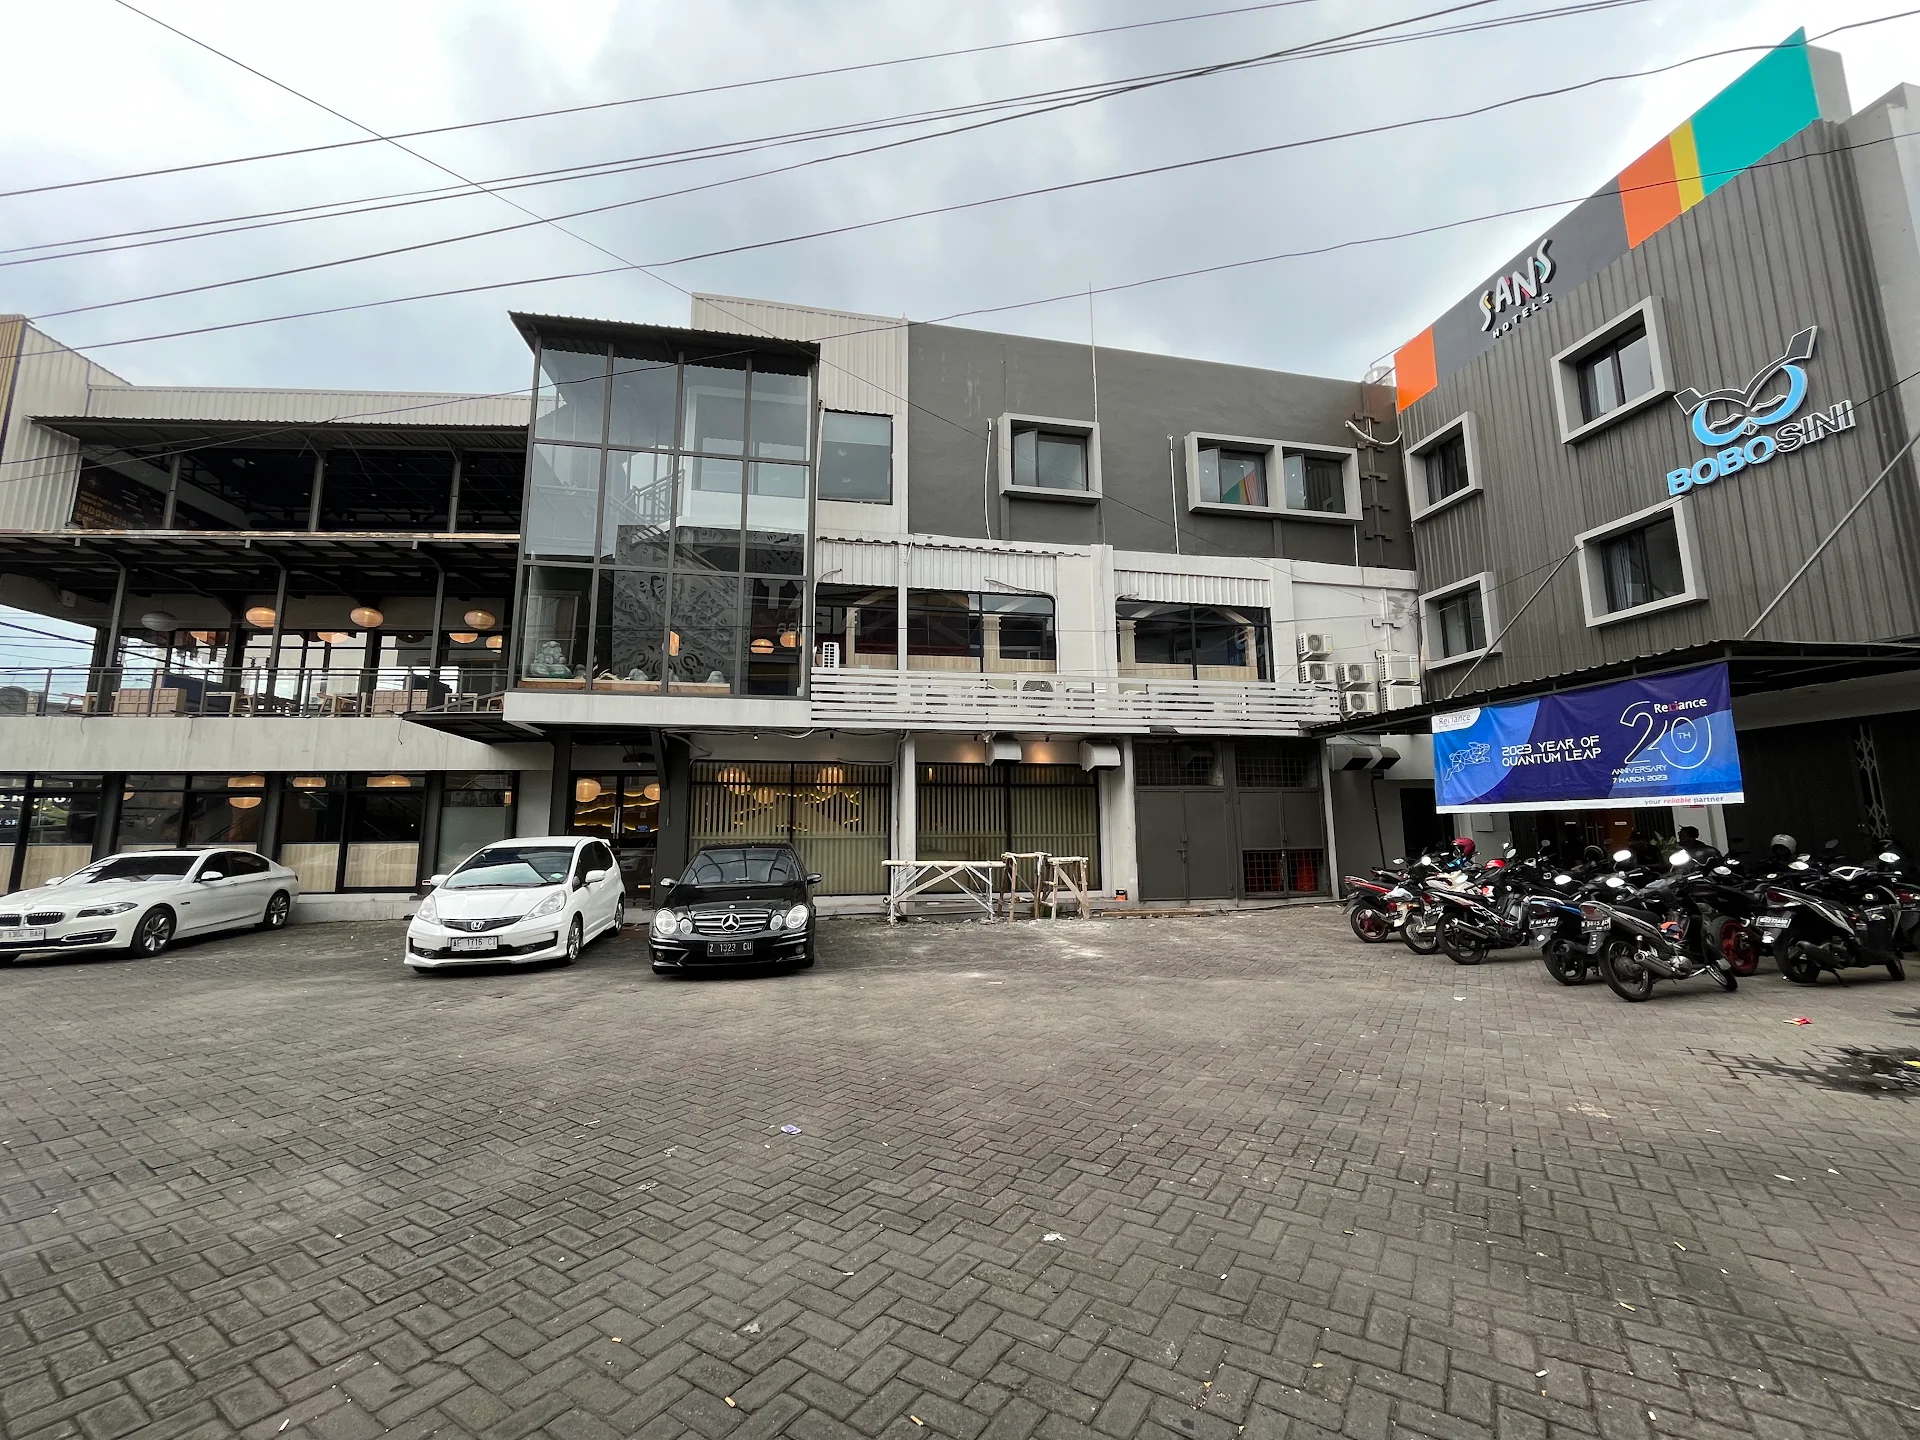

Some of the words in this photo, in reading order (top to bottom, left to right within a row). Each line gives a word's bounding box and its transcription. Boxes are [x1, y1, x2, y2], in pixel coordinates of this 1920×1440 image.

[1479, 238, 1554, 332] SANS
[1492, 292, 1552, 339] HOTELS
[1654, 698, 1707, 713] Reliance
[1502, 744, 1532, 756] 2023
[1537, 738, 1575, 752] YEAR
[1580, 735, 1600, 747] OF
[1502, 752, 1561, 767] QUANTUM
[1565, 748, 1602, 761] LEAP
[1611, 764, 1667, 775] ANNIVERSARY
[1619, 775, 1645, 783] MARCH
[1647, 774, 1668, 782] 2023
[1663, 796, 1691, 804] reliable
